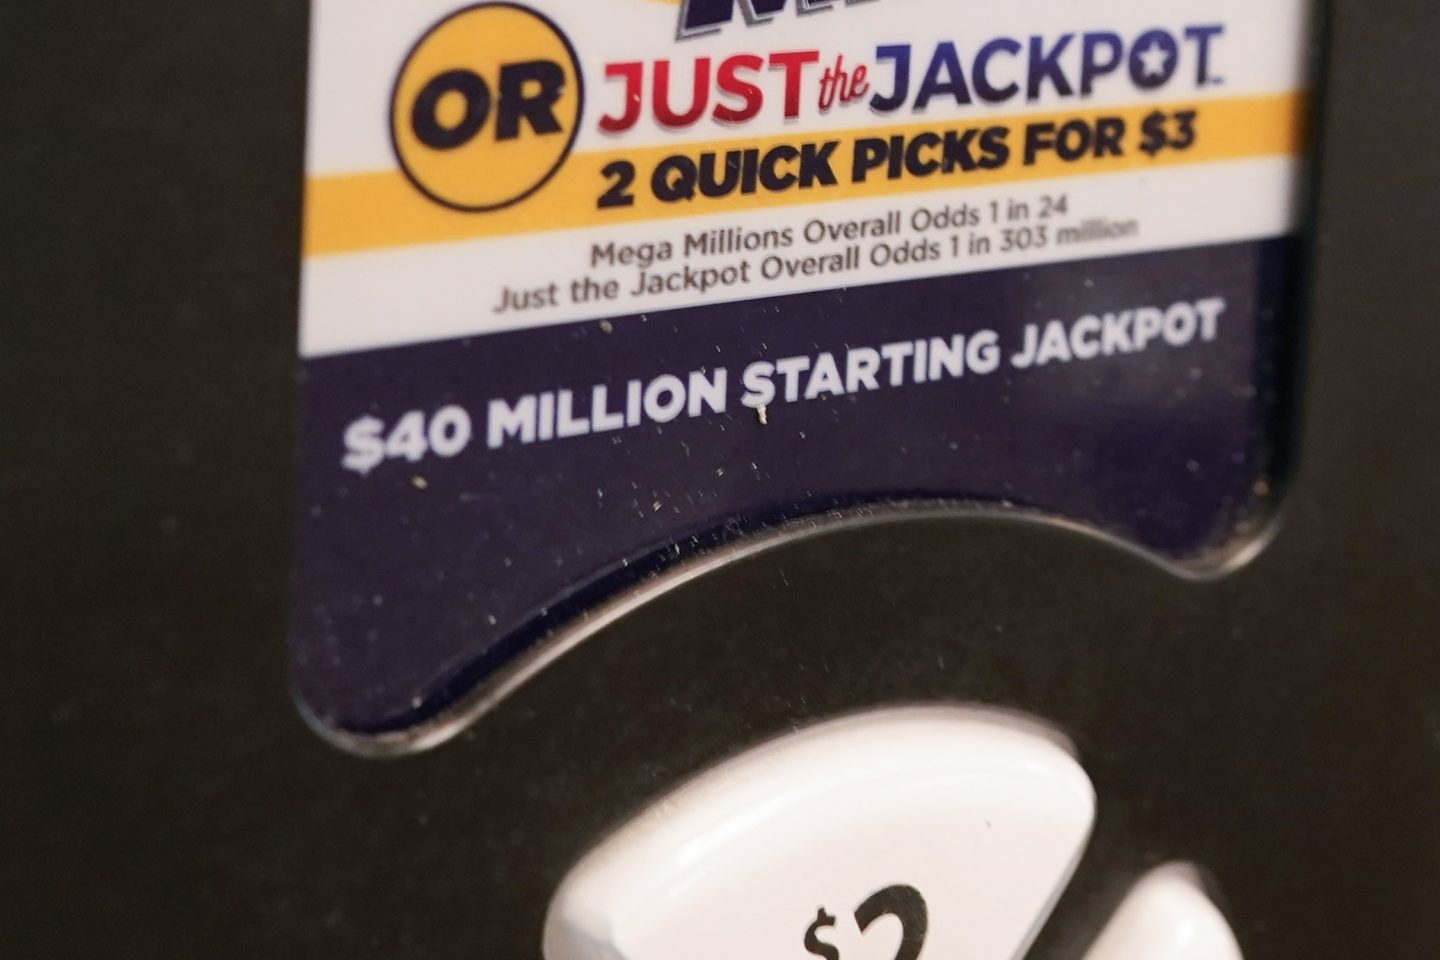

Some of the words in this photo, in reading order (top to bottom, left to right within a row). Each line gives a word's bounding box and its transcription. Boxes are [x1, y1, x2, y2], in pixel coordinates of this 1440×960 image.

[410, 58, 568, 152] OR
[598, 49, 821, 136] JUST
[817, 53, 870, 115] the
[869, 22, 1225, 116] JACKPOT
[597, 160, 636, 210] 2
[650, 139, 840, 204] QUICK
[851, 124, 1010, 184] PICKS
[1022, 114, 1126, 166] FOR
[1138, 108, 1197, 159] $3
[493, 282, 560, 315] Just
[570, 275, 620, 305] the
[630, 259, 751, 298] Jackpot
[762, 248, 859, 281] Overall
[870, 235, 940, 267] Odds
[950, 233, 960, 258] 1
[968, 230, 991, 256] in
[999, 225, 1049, 253] 303
[1054, 216, 1140, 246] million
[591, 237, 673, 271] Mega
[683, 225, 794, 256] Millions
[803, 211, 901, 242] Overall
[911, 202, 981, 233] Odds
[989, 199, 999, 224] 1
[1008, 197, 1030, 222] in
[1038, 193, 1069, 220] 24
[341, 403, 472, 476] $40
[487, 366, 728, 449] MILLION
[740, 329, 1000, 409] STARTING
[1010, 296, 1226, 370] JACKPOT
